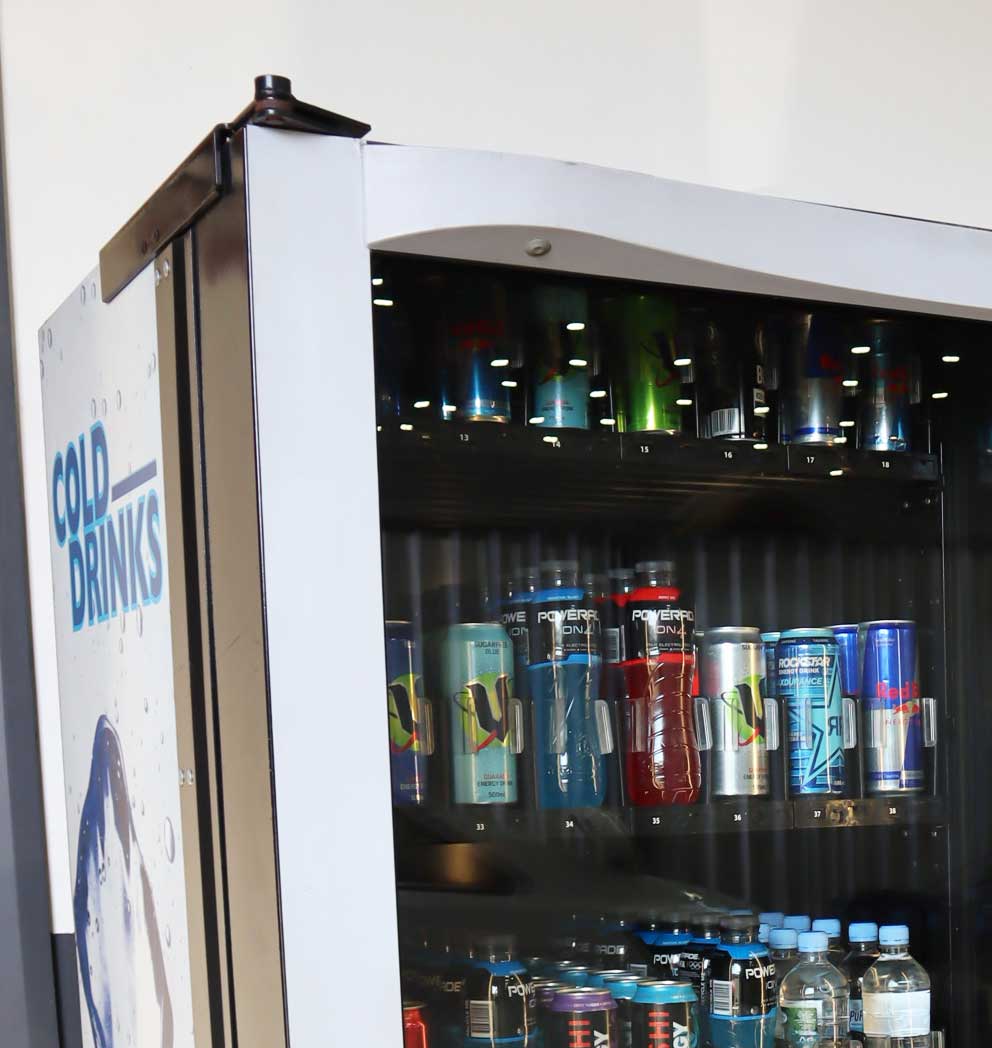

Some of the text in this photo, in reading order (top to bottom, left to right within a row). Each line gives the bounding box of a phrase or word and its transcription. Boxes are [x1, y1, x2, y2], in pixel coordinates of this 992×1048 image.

[460, 434, 469, 442] 13
[640, 446, 649, 454] 15
[806, 456, 814, 464] 17
[882, 461, 890, 469] 18
[51, 419, 110, 548] COLD
[67, 488, 163, 633] DRINKS
[778, 656, 831, 668] ROCKSTAR
[652, 817, 660, 825] 35
[734, 814, 742, 822] 36
[565, 820, 574, 828] 34
